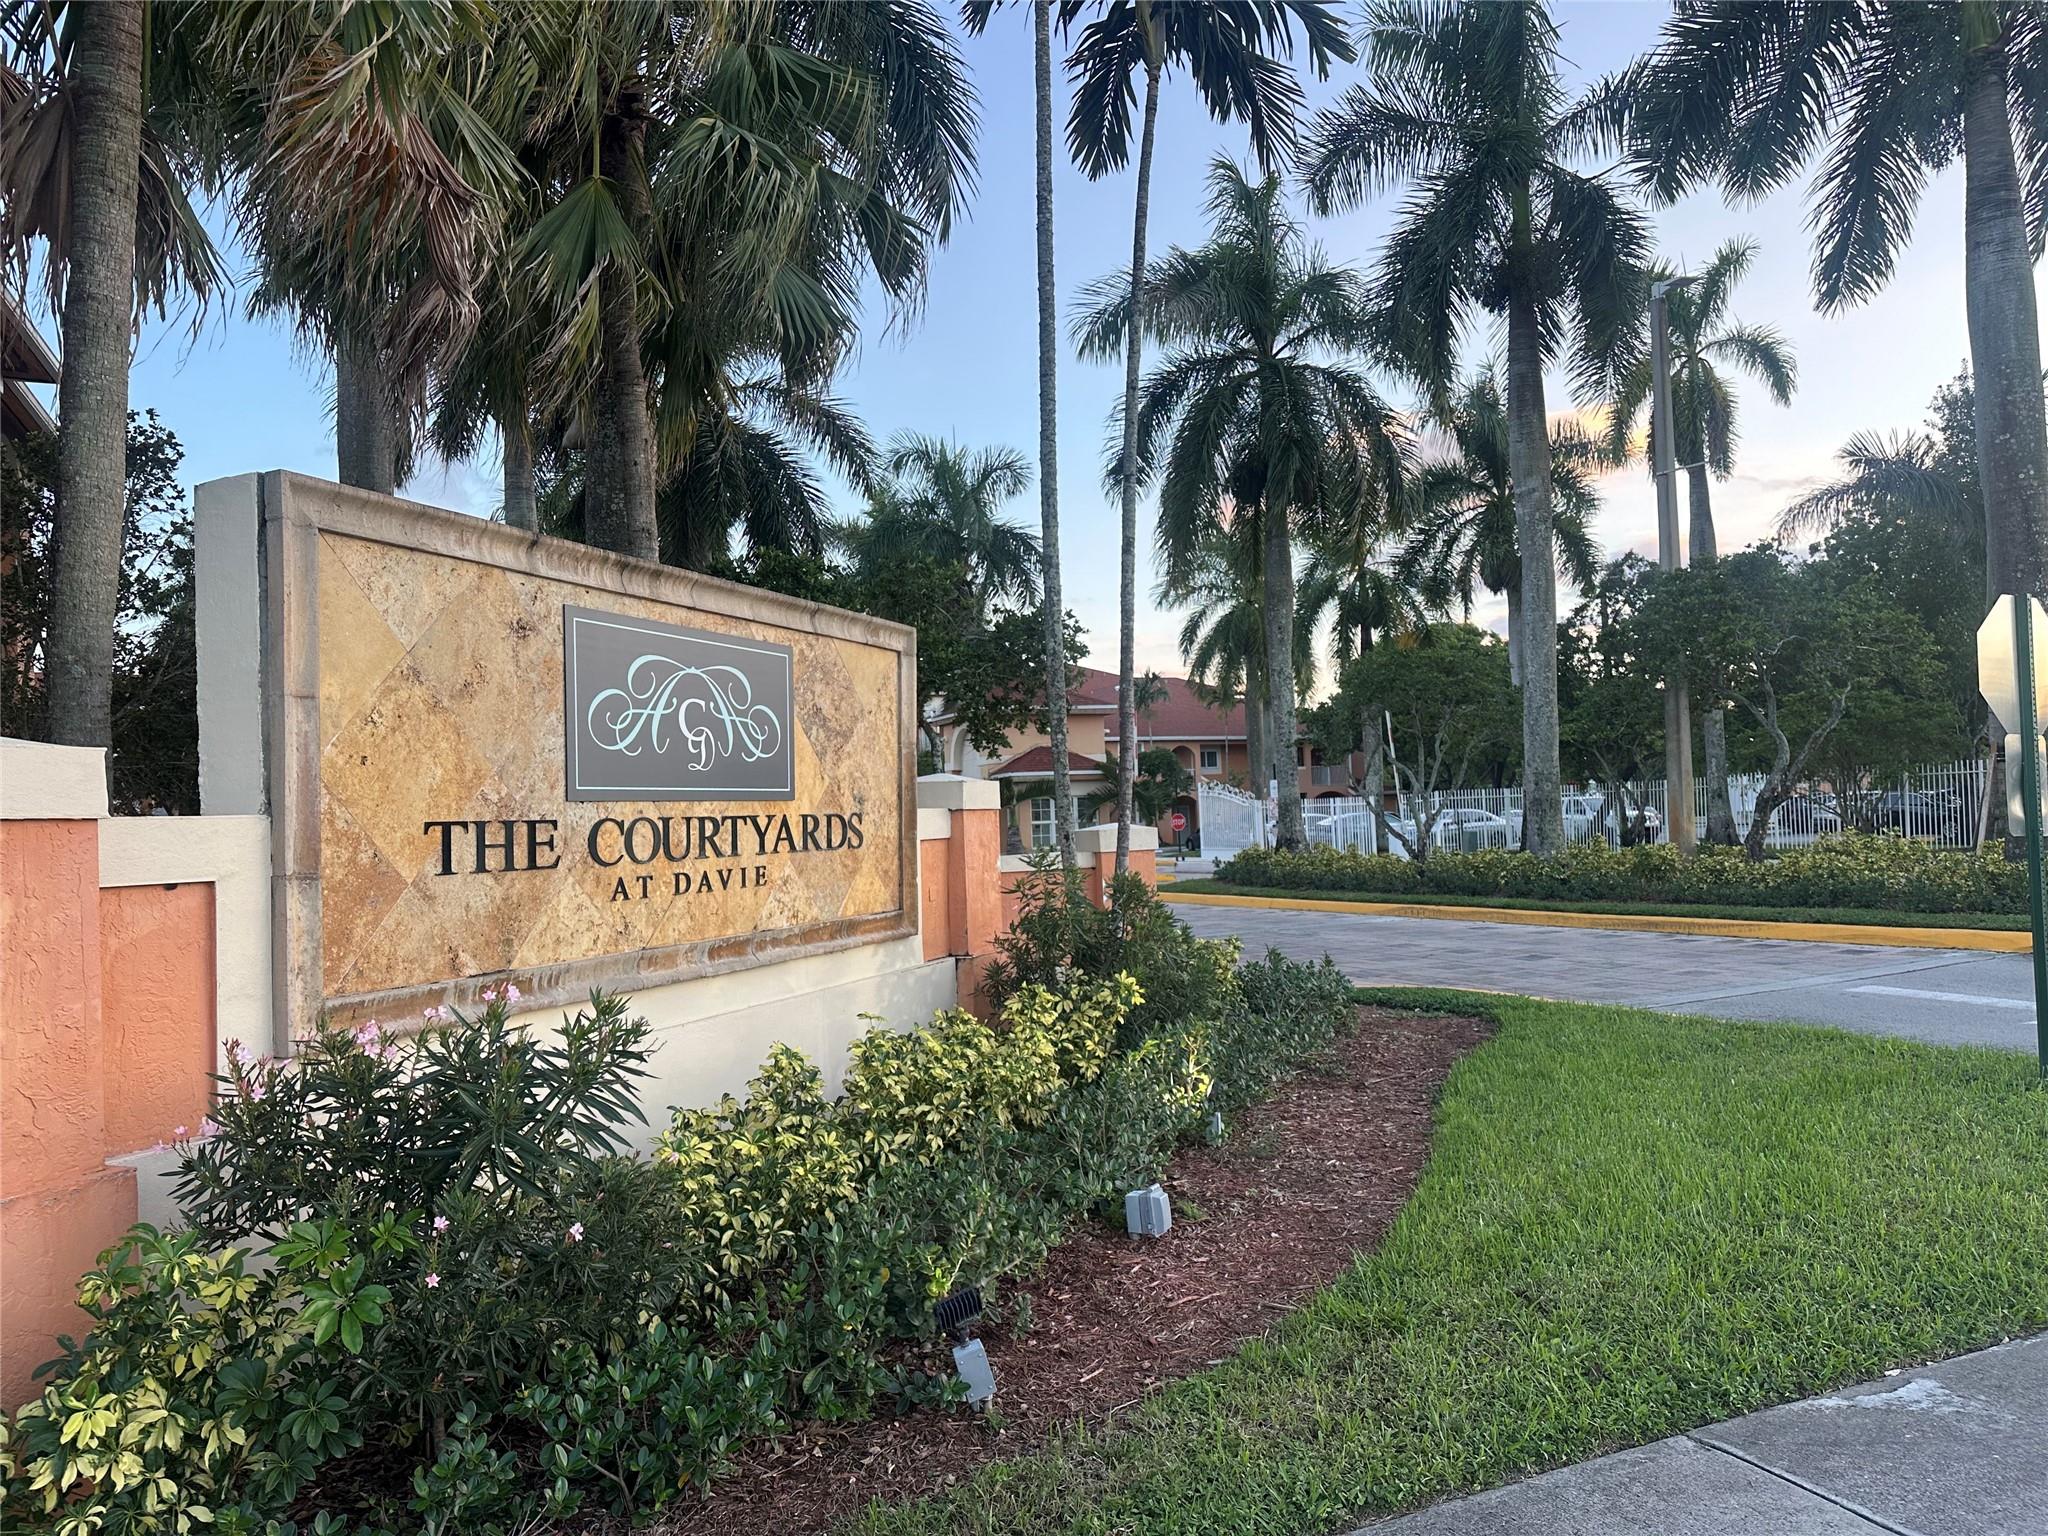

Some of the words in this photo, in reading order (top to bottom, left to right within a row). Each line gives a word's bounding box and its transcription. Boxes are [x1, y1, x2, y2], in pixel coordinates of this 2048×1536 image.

[423, 819, 561, 876] THE
[587, 811, 864, 867] COURTYARDS
[610, 875, 653, 901] AT
[673, 866, 768, 896] DAVIE
